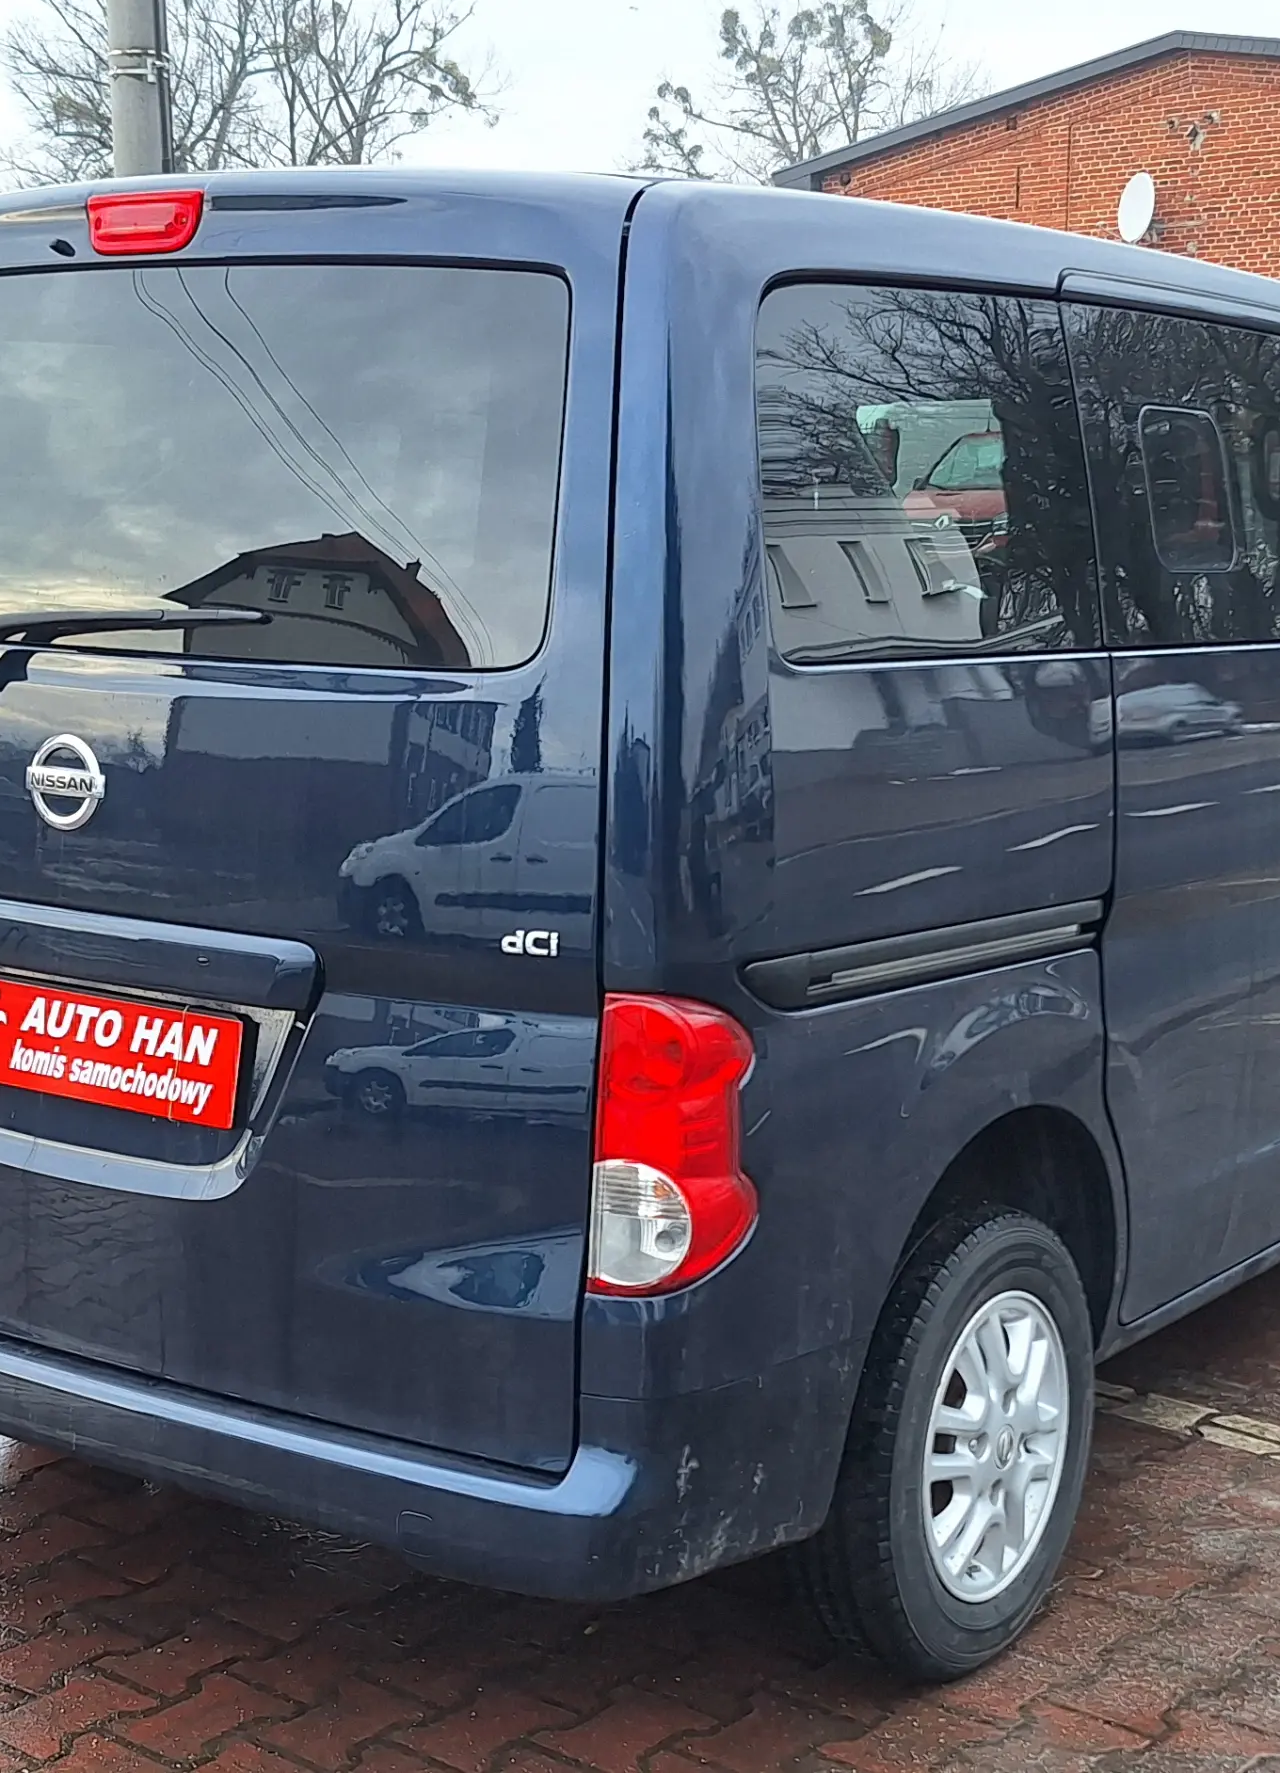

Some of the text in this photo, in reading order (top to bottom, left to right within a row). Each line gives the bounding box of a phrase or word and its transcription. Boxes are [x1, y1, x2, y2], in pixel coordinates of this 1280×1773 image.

[30, 771, 94, 793] NISSAN
[20, 996, 220, 1067] AUTO HAN
[9, 1038, 215, 1116] komis samochodowy
